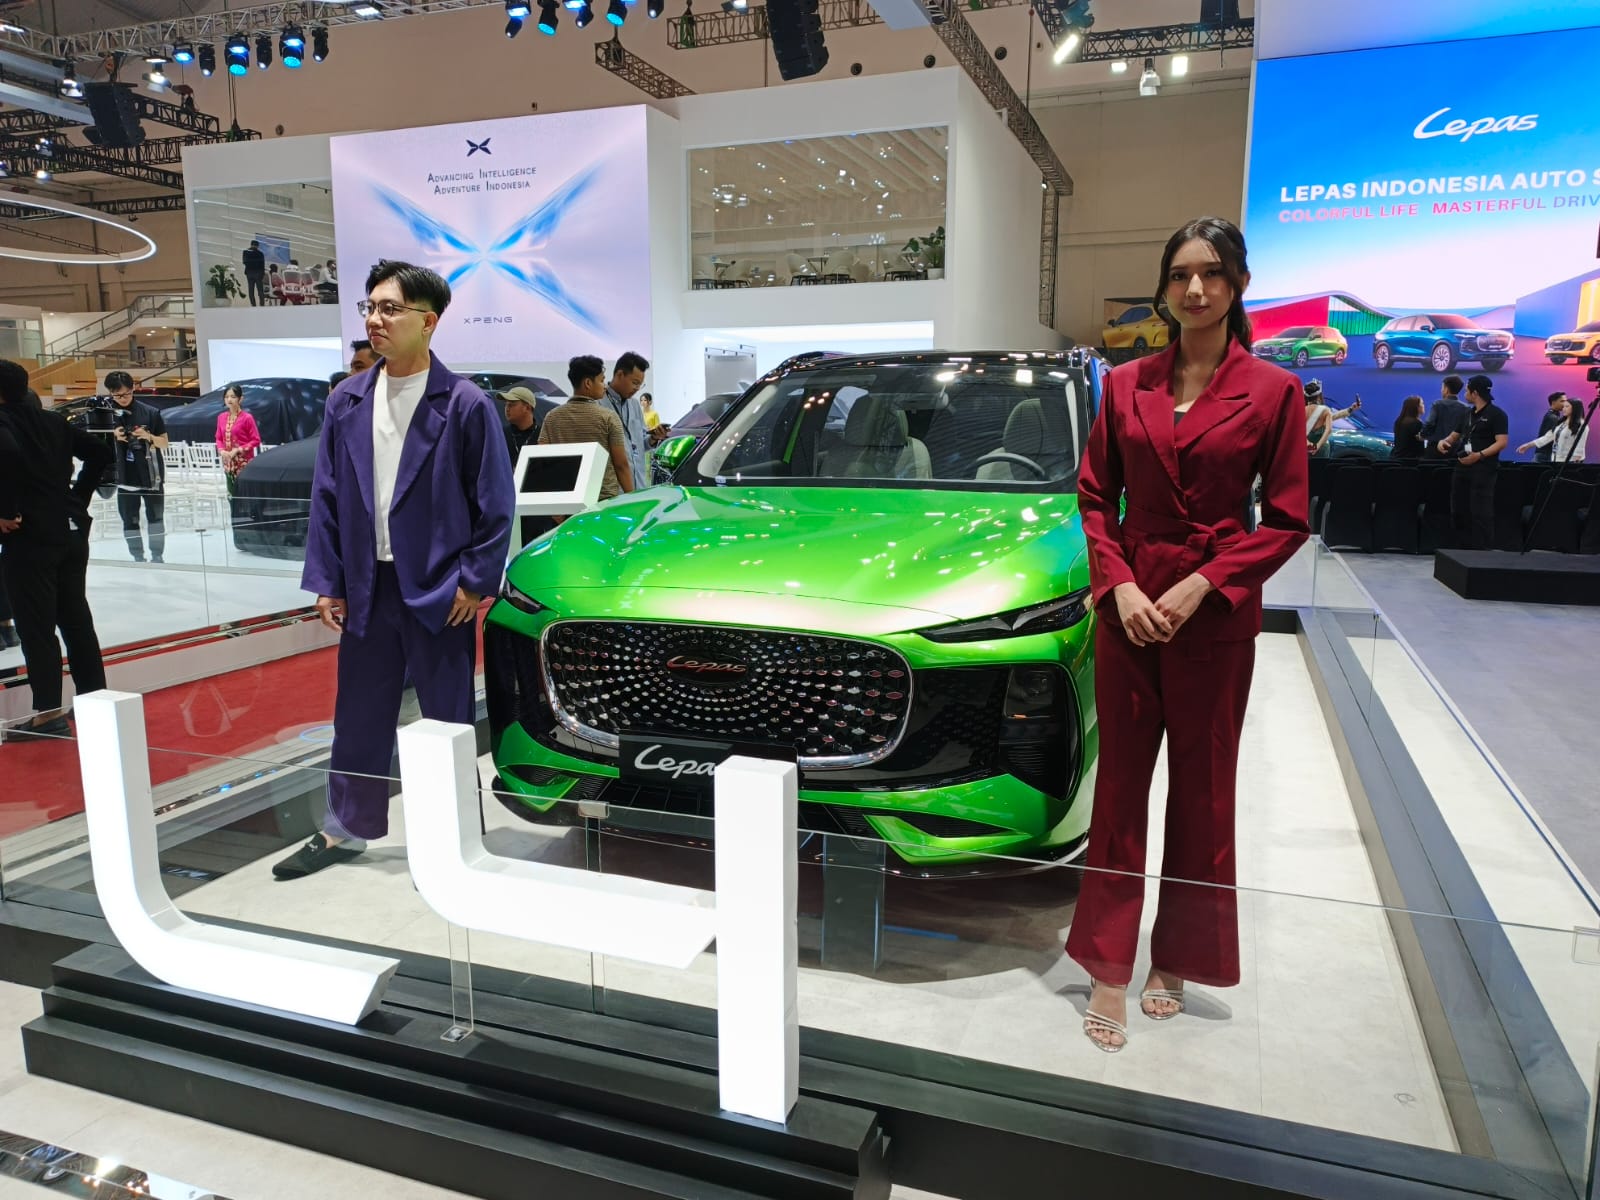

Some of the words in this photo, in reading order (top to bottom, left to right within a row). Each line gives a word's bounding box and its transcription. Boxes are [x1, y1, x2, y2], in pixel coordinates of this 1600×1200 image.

[1413, 106, 1540, 143] Lepas
[427, 171, 474, 183] ADVANCING
[479, 166, 537, 179] INTELLIGENCE
[434, 184, 481, 195] ADVENTURE
[486, 181, 531, 191] INDONESIA
[1280, 182, 1357, 203] LEPAS
[1361, 173, 1505, 198] INDONESIA
[1510, 169, 1587, 190] AUTO
[1278, 206, 1375, 223] COLORFUL
[1380, 203, 1420, 218] LIFE
[1432, 197, 1547, 215] MASTERFUL
[463, 316, 513, 325] XPENG
[666, 655, 748, 673] Lepas
[634, 744, 716, 779] Lepa
